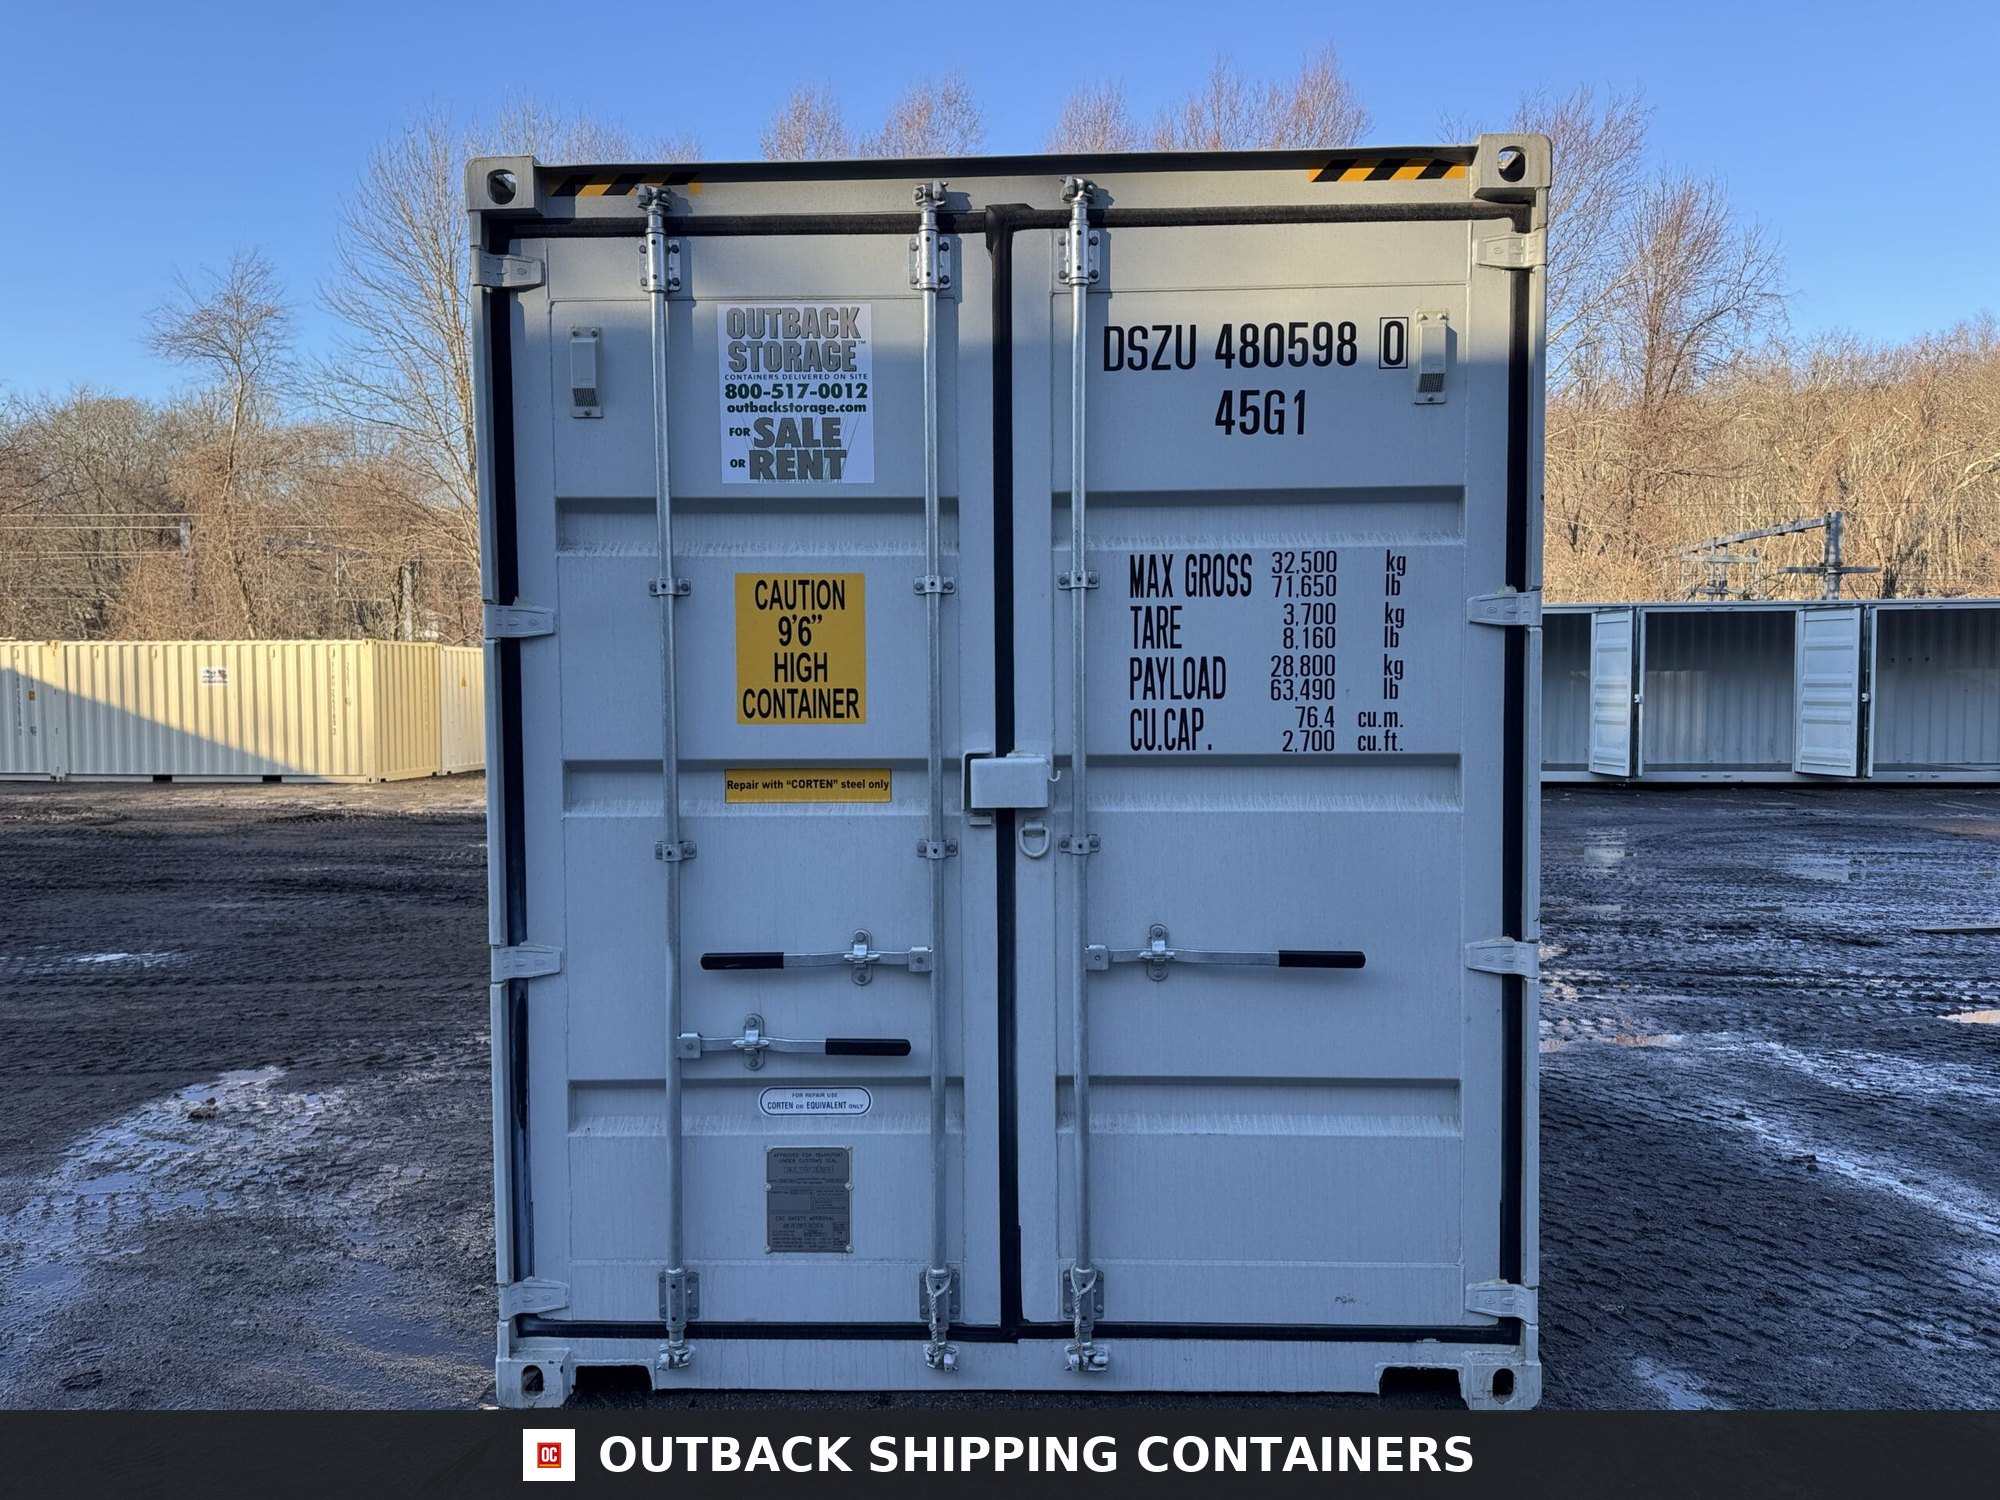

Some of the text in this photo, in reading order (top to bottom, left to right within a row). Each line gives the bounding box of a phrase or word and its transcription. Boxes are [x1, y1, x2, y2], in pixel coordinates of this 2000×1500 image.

[726, 307, 861, 340] OUTBACK
[728, 341, 858, 372] STORAGE
[1104, 320, 1404, 371] DSZU 480598 0
[725, 382, 868, 400] 800-517-0012
[727, 401, 867, 415] outbackstorage.com
[1215, 389, 1306, 436] 45G1
[729, 418, 842, 448] FOR SALE
[730, 450, 847, 480] OR RENT
[1130, 554, 1252, 598] MAX GROSS
[1272, 550, 1406, 576] 32,500 kg
[755, 580, 846, 610] CAUTION
[1273, 574, 1400, 598] 71,650 lb
[1130, 605, 1182, 649] TARE
[1283, 602, 1405, 628] 3,700 kg
[1283, 626, 1400, 650] 8,160 lb
[774, 652, 828, 683] HIGH
[1130, 656, 1226, 700] PAYLOAD
[1270, 654, 1404, 680] 28,800 kg
[742, 688, 860, 719] CONTAINER
[1270, 678, 1399, 702] 63,490 lb
[1130, 708, 1213, 751] CU.CAP.
[1295, 706, 1404, 728] 76.4 cu.m.
[1282, 730, 1404, 752] 2,700 cu.ft.
[727, 779, 759, 791] Repair
[762, 779, 784, 789] with
[840, 779, 866, 789] steel
[868, 779, 890, 791] only
[768, 1102, 794, 1110] CORTEN
[806, 1102, 846, 1110] EQUIVALENT
